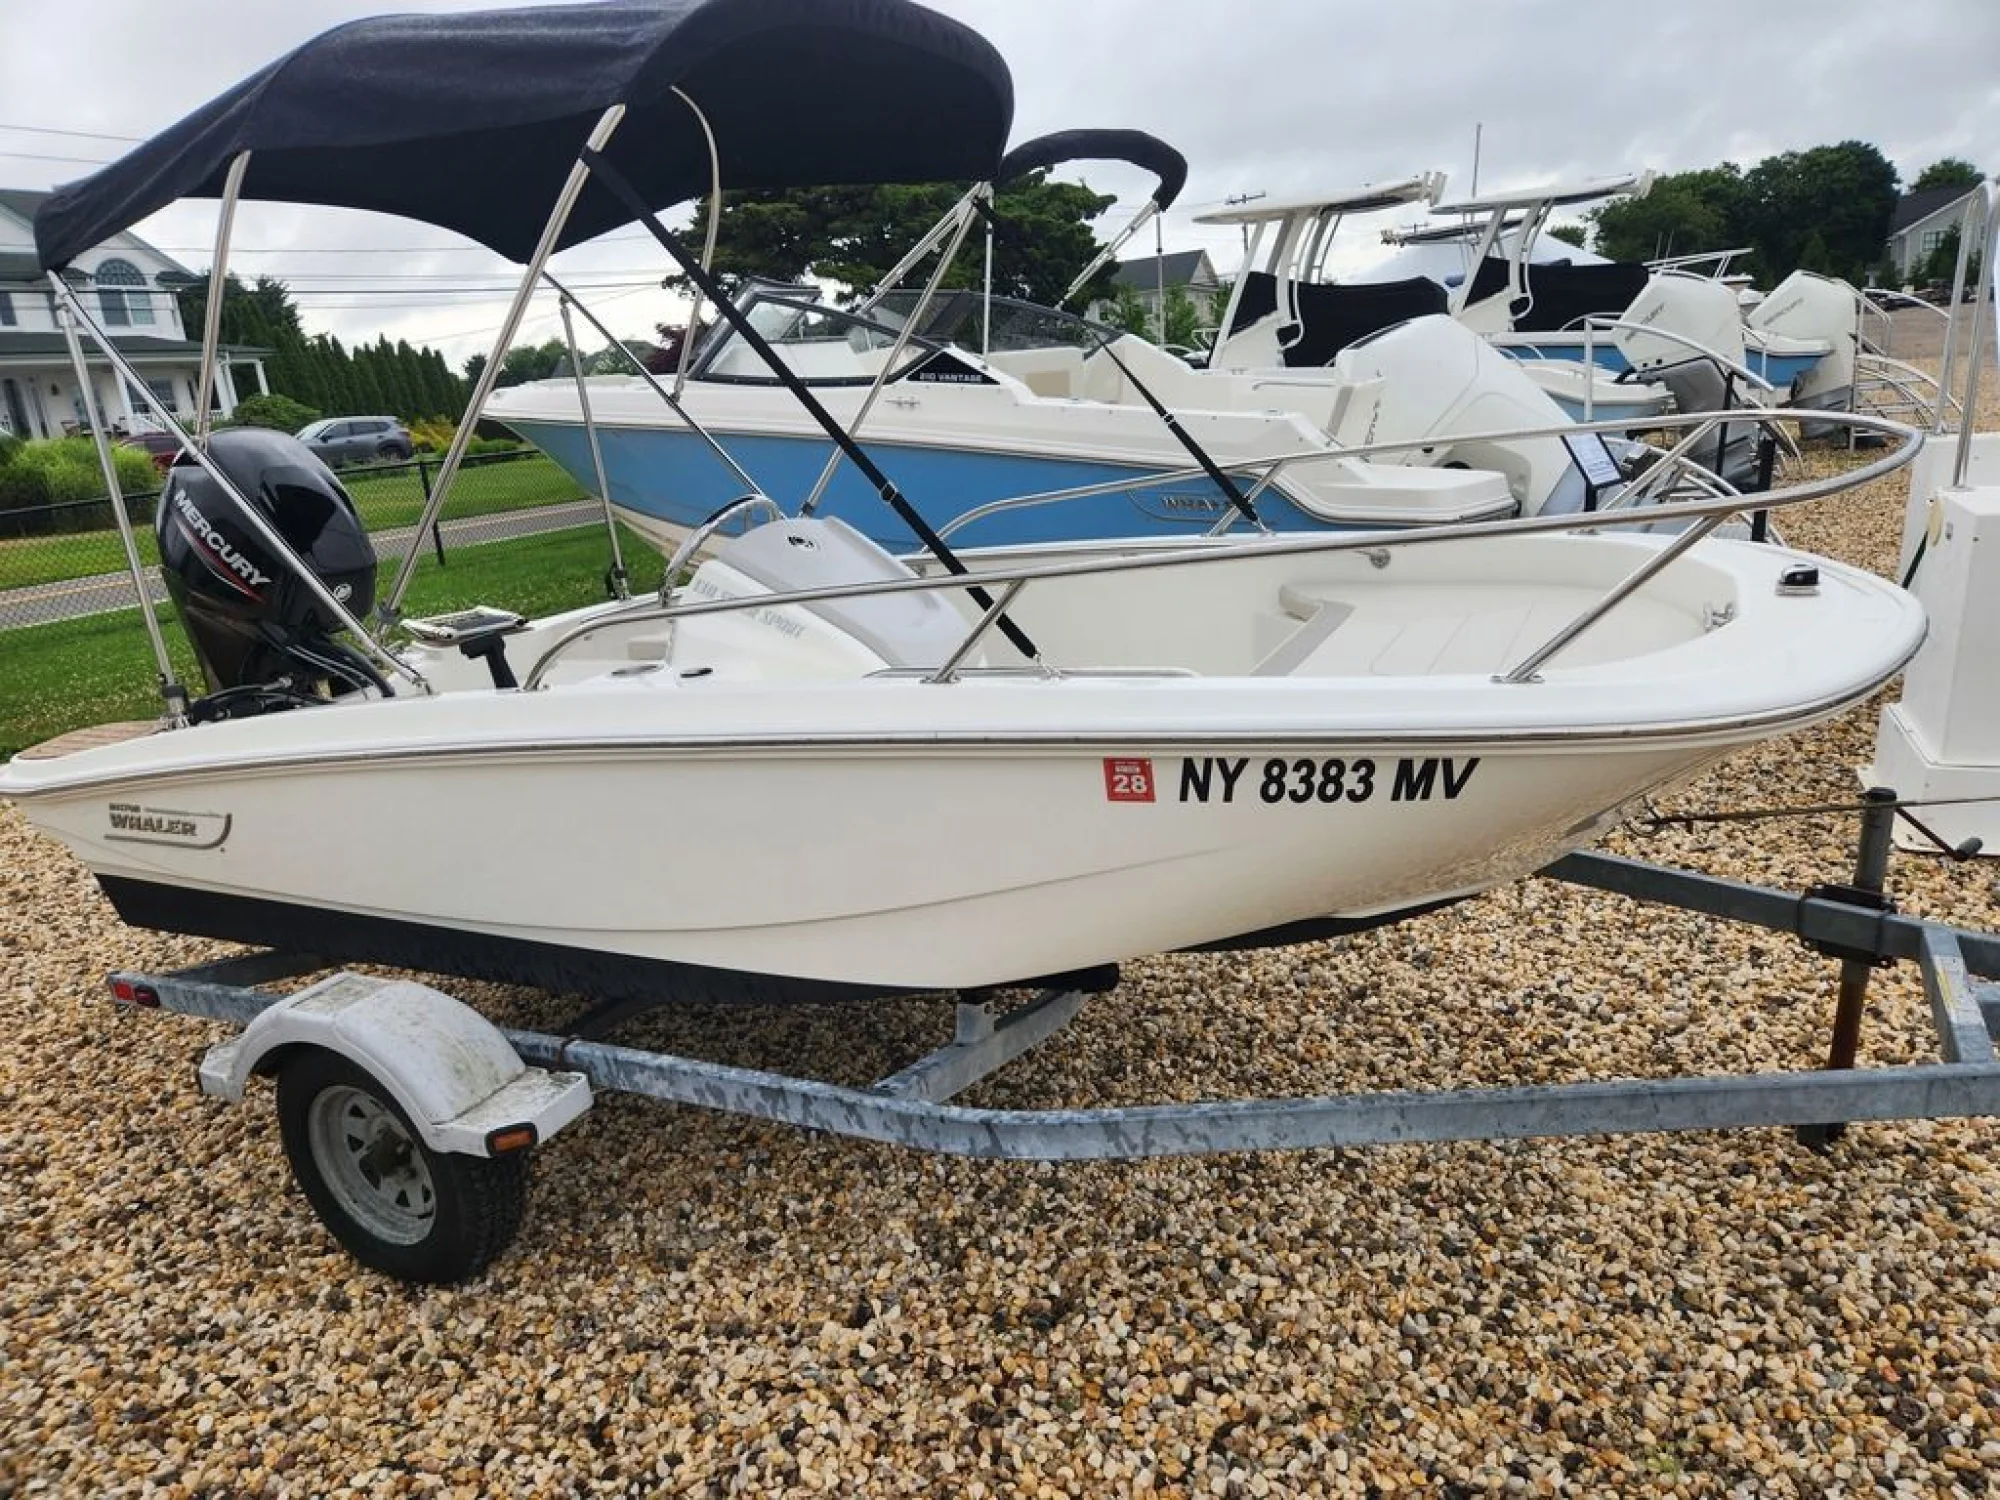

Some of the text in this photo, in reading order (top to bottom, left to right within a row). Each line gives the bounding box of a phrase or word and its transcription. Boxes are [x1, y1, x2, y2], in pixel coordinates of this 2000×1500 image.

[174, 488, 273, 586] MERCURY
[1112, 774, 1148, 794] 28
[1180, 757, 1481, 804] NY 8383 MV
[109, 812, 198, 837] WHALER
